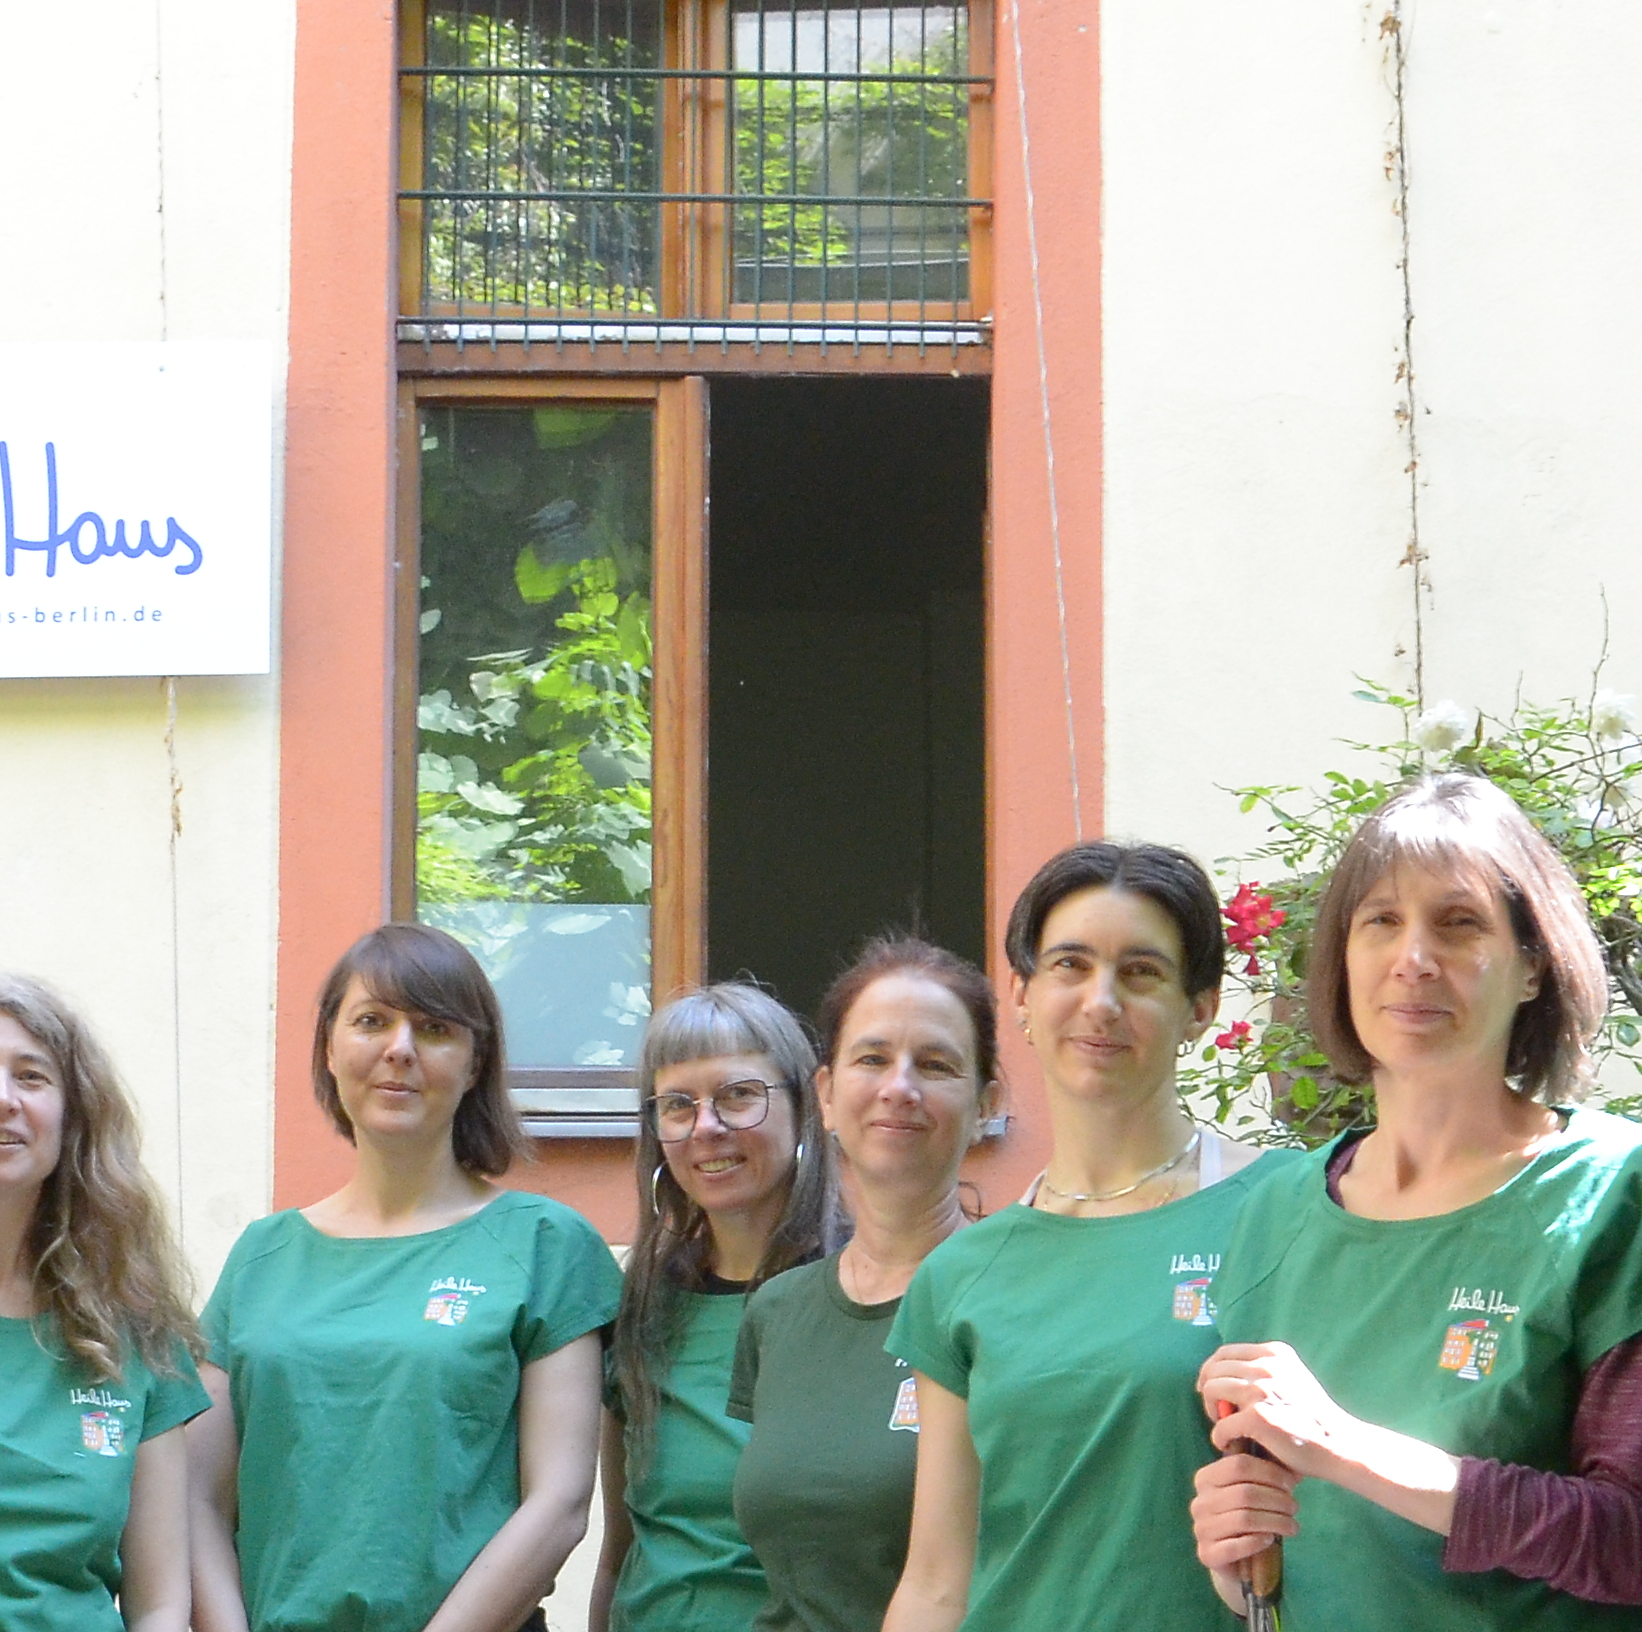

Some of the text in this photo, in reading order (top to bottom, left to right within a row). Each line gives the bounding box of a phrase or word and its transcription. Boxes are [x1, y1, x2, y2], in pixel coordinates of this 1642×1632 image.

[1170, 1254, 1207, 1274] Heile
[1448, 1287, 1486, 1311] Heile
[69, 1387, 132, 1408] Heile Haus
